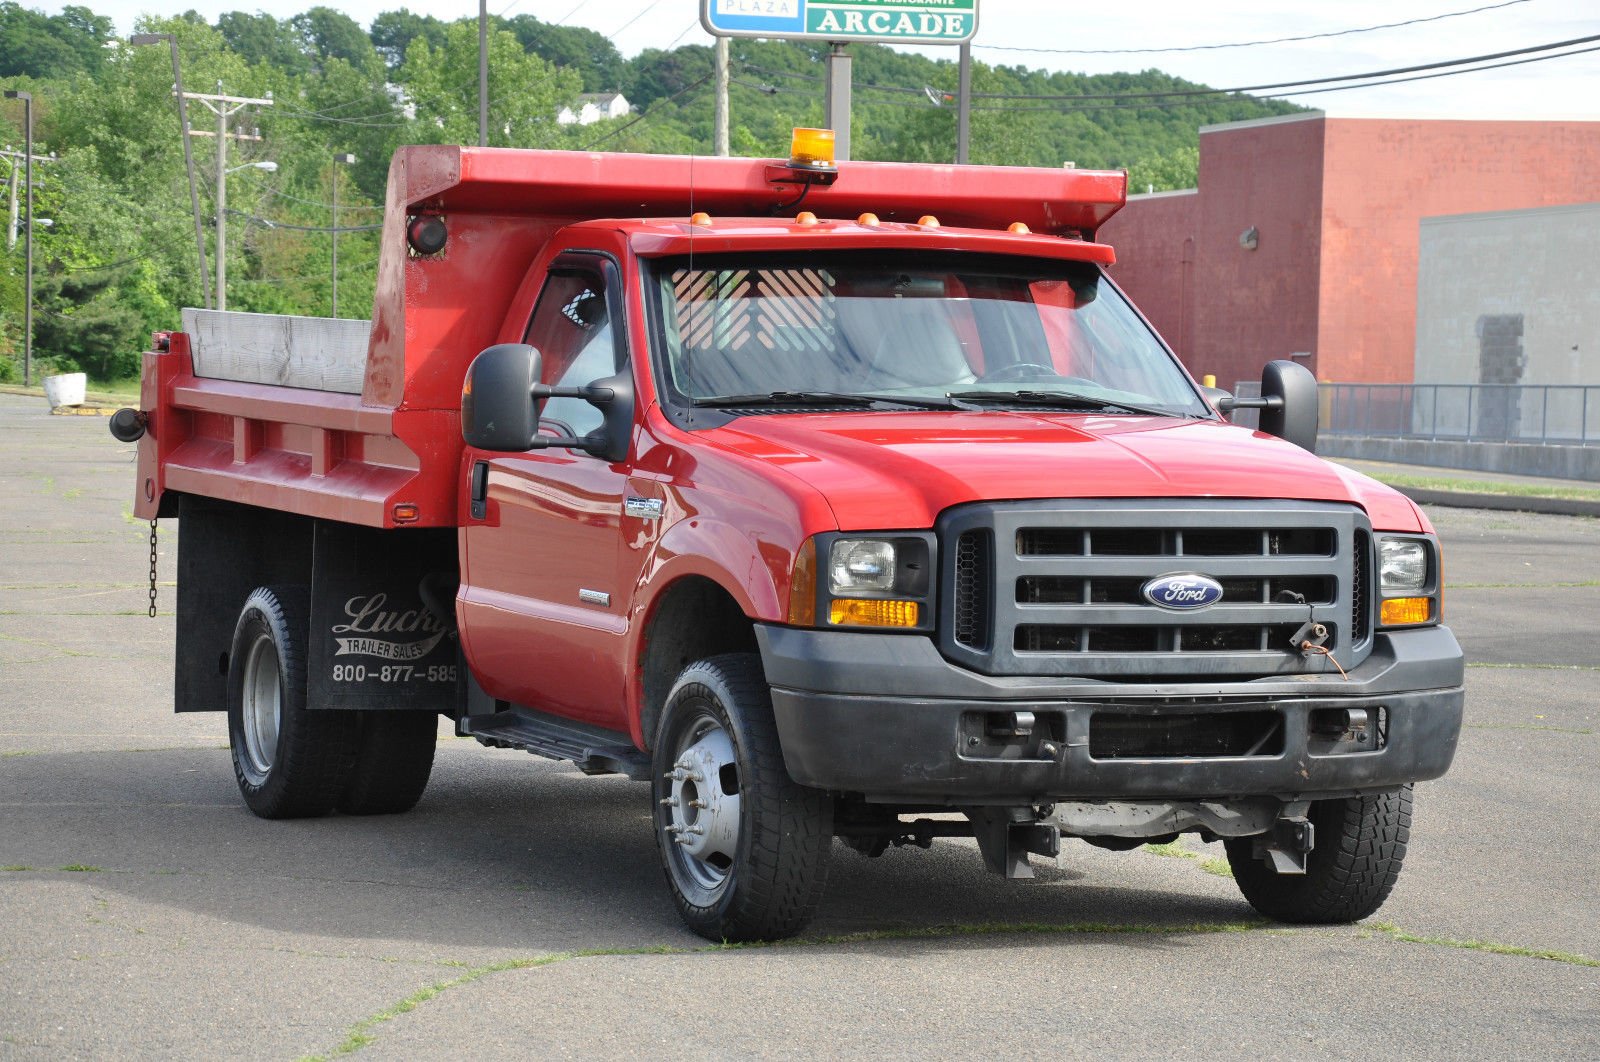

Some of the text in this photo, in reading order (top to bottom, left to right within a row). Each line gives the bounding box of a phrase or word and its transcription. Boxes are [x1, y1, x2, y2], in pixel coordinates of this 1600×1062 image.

[725, 0, 790, 13] PLAZA
[815, 9, 965, 36] ARCADE
[1164, 581, 1208, 601] Ford
[346, 639, 424, 659] TRAILER SALES
